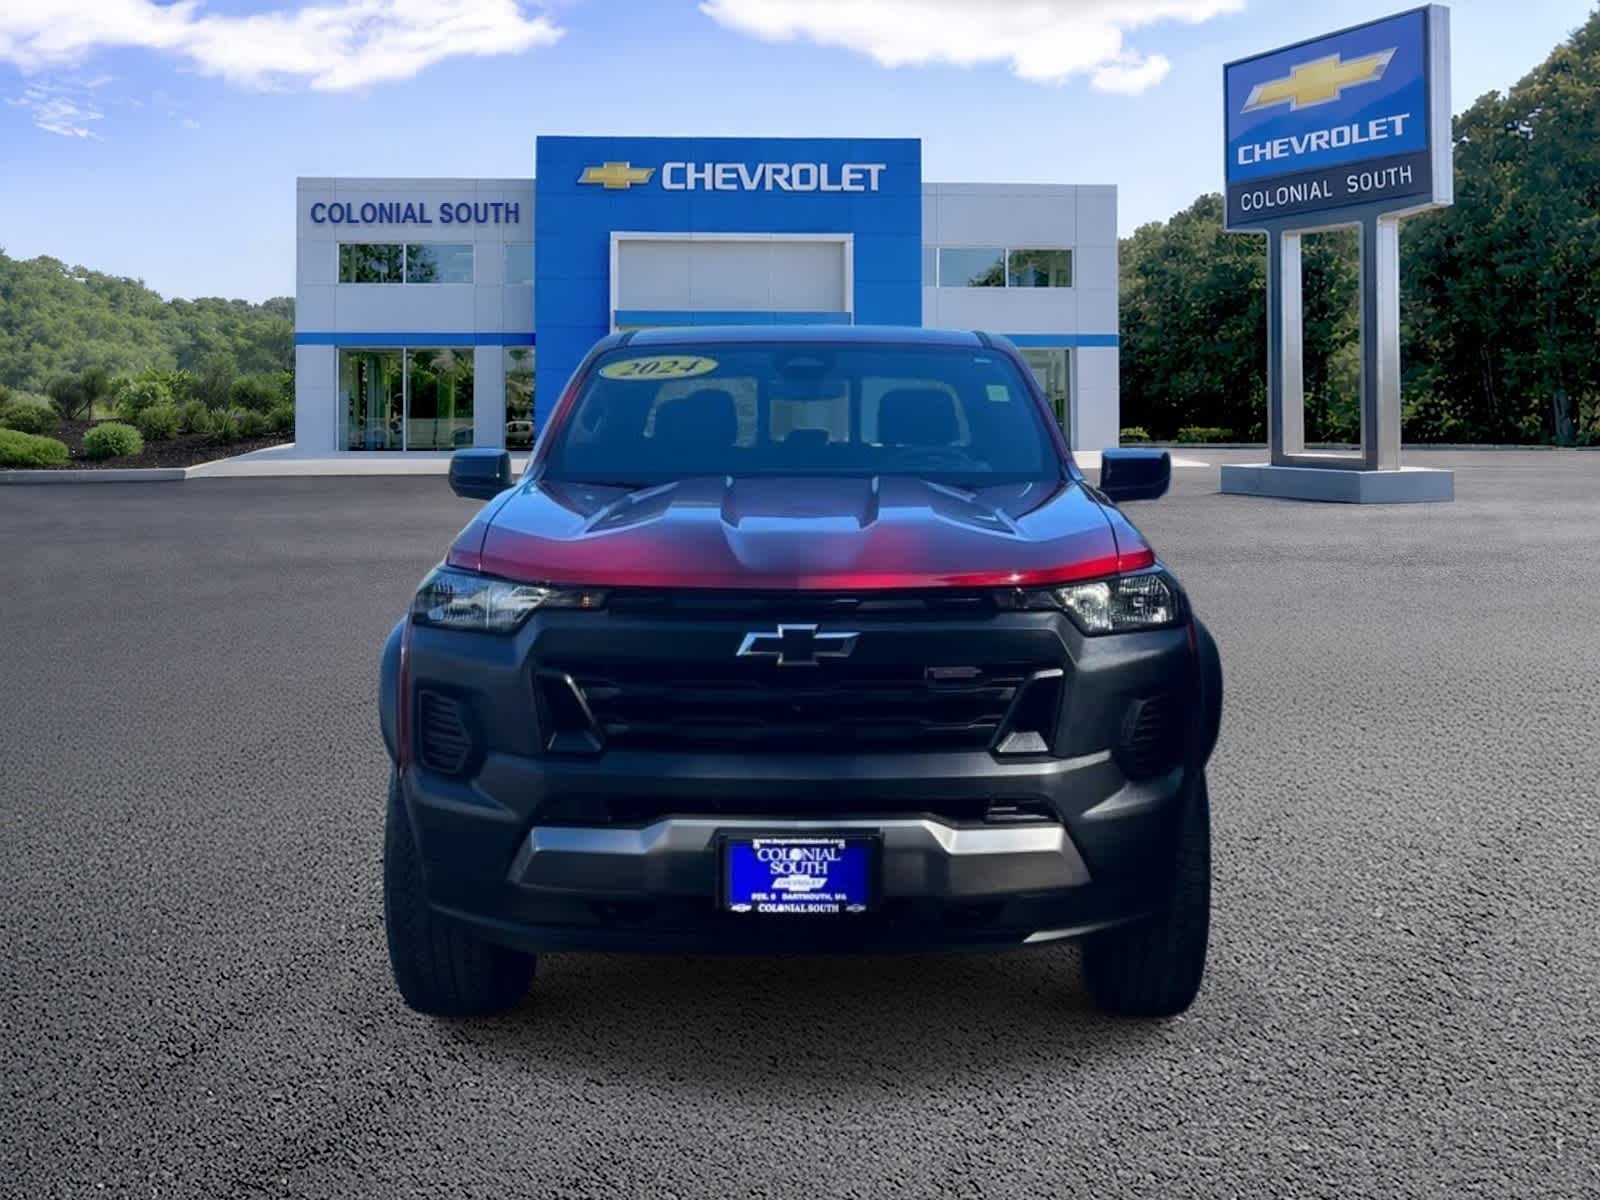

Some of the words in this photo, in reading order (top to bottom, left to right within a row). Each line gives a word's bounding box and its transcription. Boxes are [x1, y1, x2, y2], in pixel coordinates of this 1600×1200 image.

[1238, 113, 1410, 165] CHEVROLET
[662, 161, 887, 192] CHEVROLET
[1241, 179, 1333, 211] COLONIAL
[1346, 165, 1412, 193] SOUTH
[310, 202, 433, 224] COLONIAL
[439, 202, 520, 224] SOUTH
[617, 358, 704, 377] 2024
[757, 848, 842, 862] COLONIAL
[769, 861, 829, 875] SOUTH
[758, 903, 807, 913] COLONIAL
[807, 903, 840, 913] SOUTH
